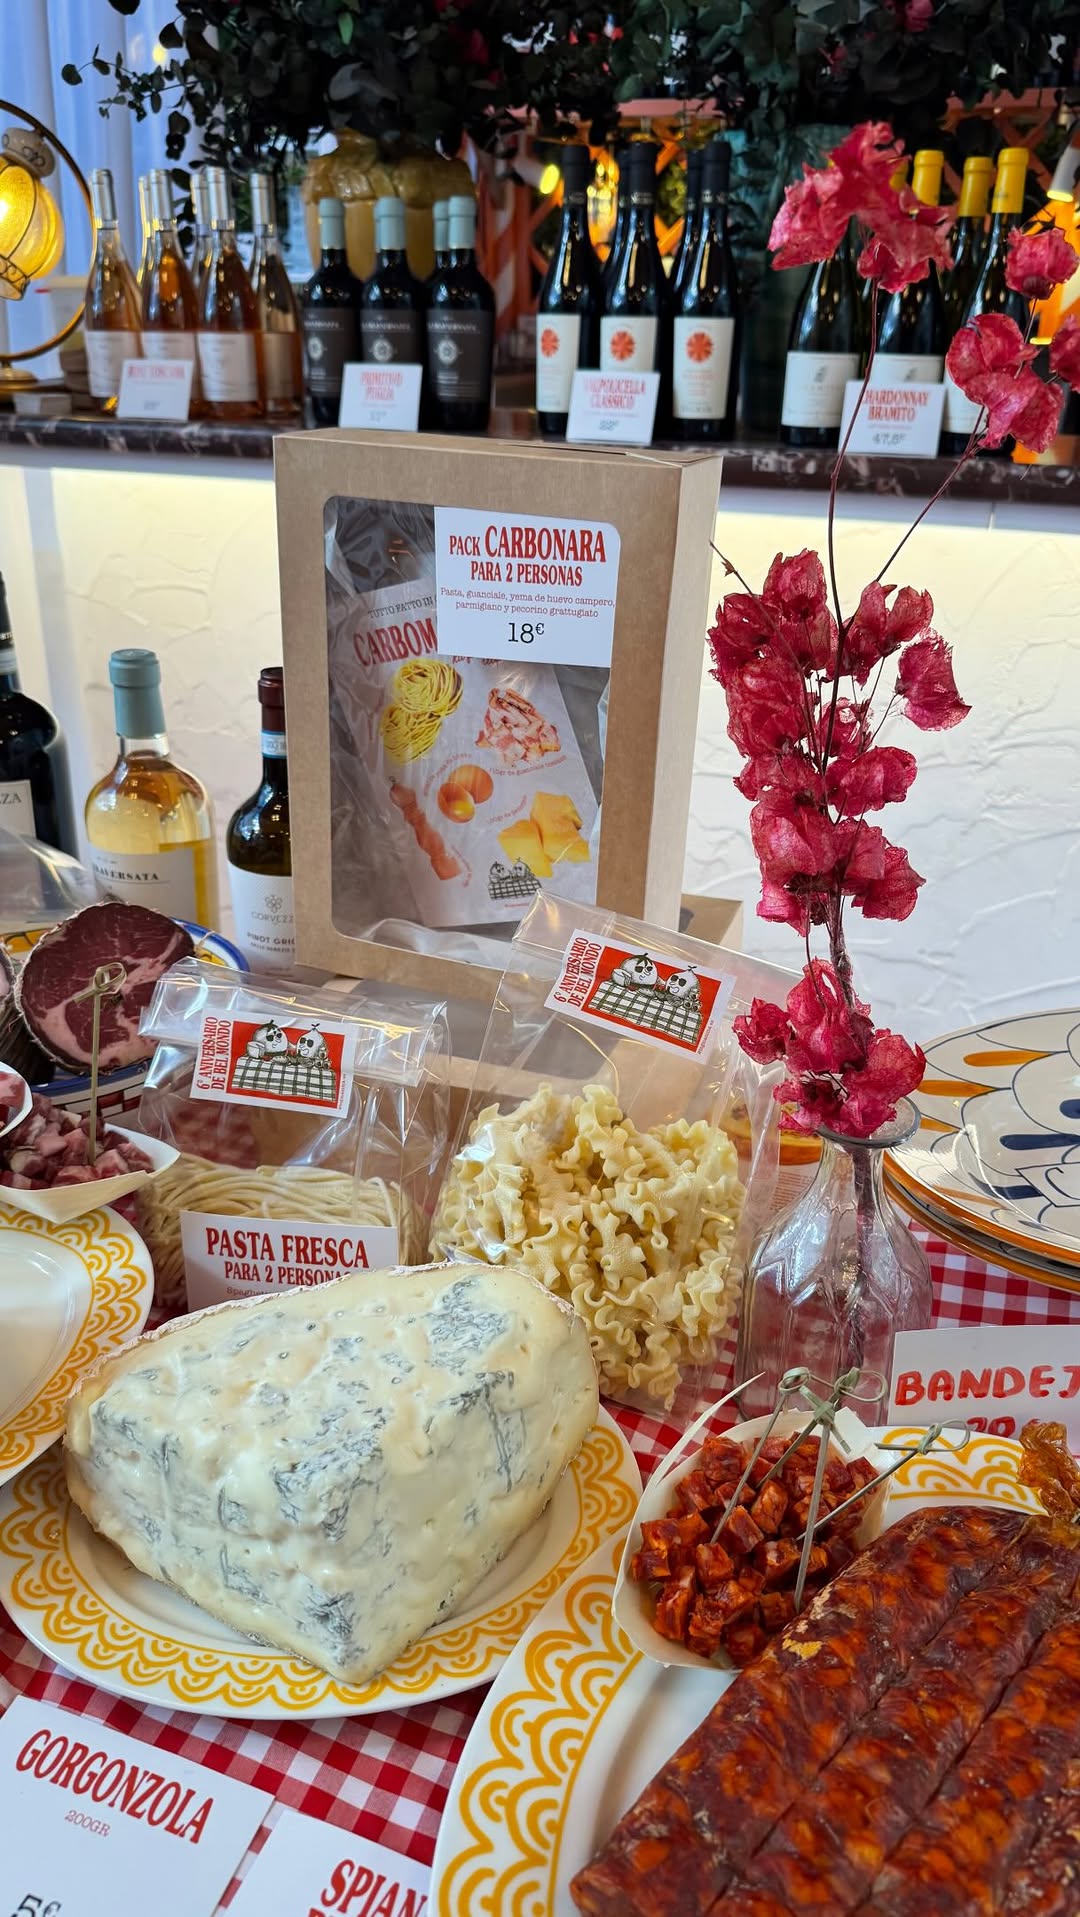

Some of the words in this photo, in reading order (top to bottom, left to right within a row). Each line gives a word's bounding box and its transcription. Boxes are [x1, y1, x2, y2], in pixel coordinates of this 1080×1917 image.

[449, 535, 481, 556] PACK
[484, 525, 607, 563] CARBONARA
[471, 561, 502, 582] PARA
[506, 562, 513, 583] 2
[517, 563, 583, 587] PERSONAS
[368, 606, 395, 619] TUTTO
[422, 596, 434, 608] IN
[440, 587, 465, 599] Pasta,
[467, 590, 508, 601] guanciale,
[509, 593, 532, 602] yema
[535, 593, 546, 602] de
[547, 594, 574, 604] huevo
[575, 597, 616, 608] campero,
[456, 601, 502, 612] parmigiano
[503, 605, 510, 614] y
[511, 605, 548, 616] pecorino
[549, 607, 599, 618] grattugiato
[508, 622, 545, 644] 18€
[247, 931, 271, 944] PINOT
[559, 937, 589, 994] ANIVERSARIO
[567, 993, 582, 1007] DE
[575, 978, 592, 1000] BEL
[584, 943, 602, 977] MONDO
[199, 1016, 218, 1079] ANIVERSARIO
[216, 1020, 232, 1055] MONDO
[213, 1055, 227, 1075] BEL
[211, 1076, 225, 1091] DE
[205, 1227, 275, 1262] PASTA
[281, 1234, 370, 1269] FRESCA
[224, 1261, 261, 1282] PARA
[265, 1266, 273, 1283] 2
[895, 1365, 1080, 1406] BANDEJ
[15, 1728, 215, 1844] GORGONZOLA
[64, 1809, 111, 1837] 200GR
